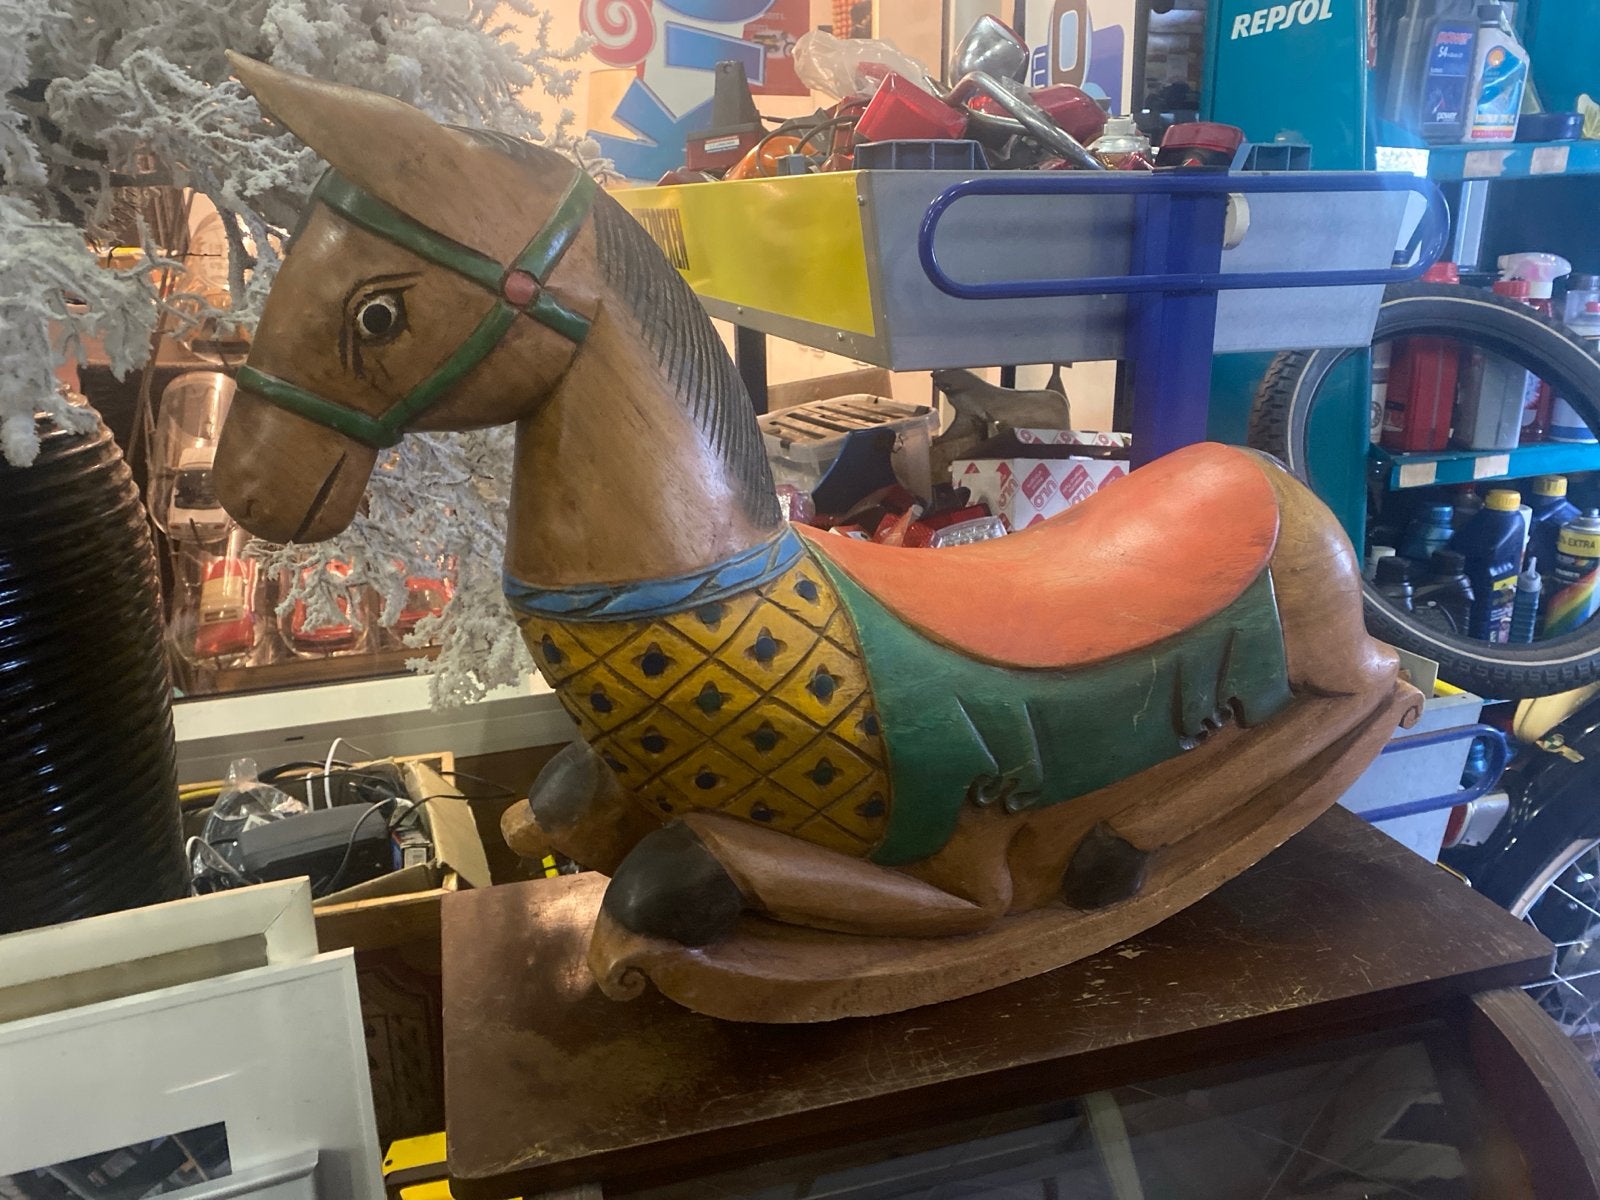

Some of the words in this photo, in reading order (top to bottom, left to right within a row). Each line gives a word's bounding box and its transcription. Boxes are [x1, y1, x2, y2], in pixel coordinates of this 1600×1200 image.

[1231, 0, 1333, 40] REPSOL
[1033, 479, 1058, 508] ULO
[1568, 537, 1596, 549] EXTRA
